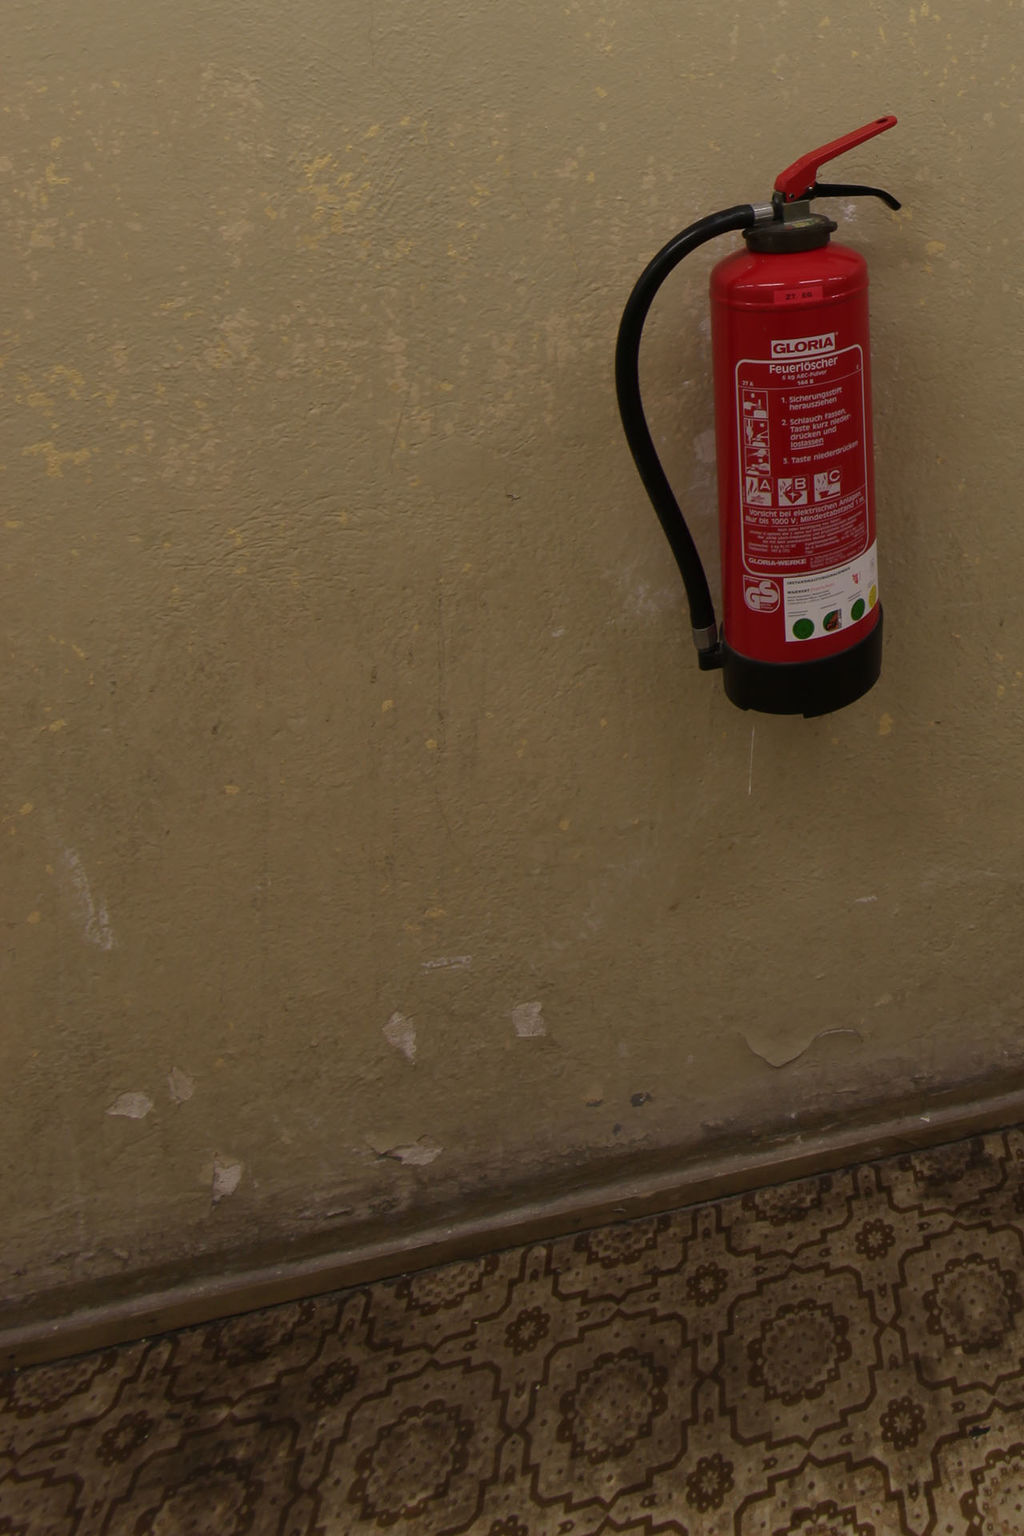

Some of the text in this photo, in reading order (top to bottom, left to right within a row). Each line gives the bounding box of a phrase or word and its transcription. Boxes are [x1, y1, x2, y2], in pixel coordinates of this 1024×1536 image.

[773, 337, 833, 354] GLORIA
[769, 356, 838, 374] Feuerlöscher
[789, 386, 843, 403] Sicherungsstift
[789, 397, 837, 411] herausziehen
[789, 414, 823, 425] Schlauch
[790, 425, 811, 433] Taste
[812, 421, 829, 430] kurz
[790, 425, 837, 440] drücken und
[790, 438, 824, 448] loslassen
[791, 456, 811, 464] Taste
[813, 440, 858, 460] niederdrücken
[828, 470, 840, 482] C
[760, 480, 770, 490] A
[795, 477, 806, 490] B
[749, 508, 777, 517] Vorsicht
[793, 503, 838, 516] elektrischen
[748, 557, 807, 566] GLORIA-WERKE
